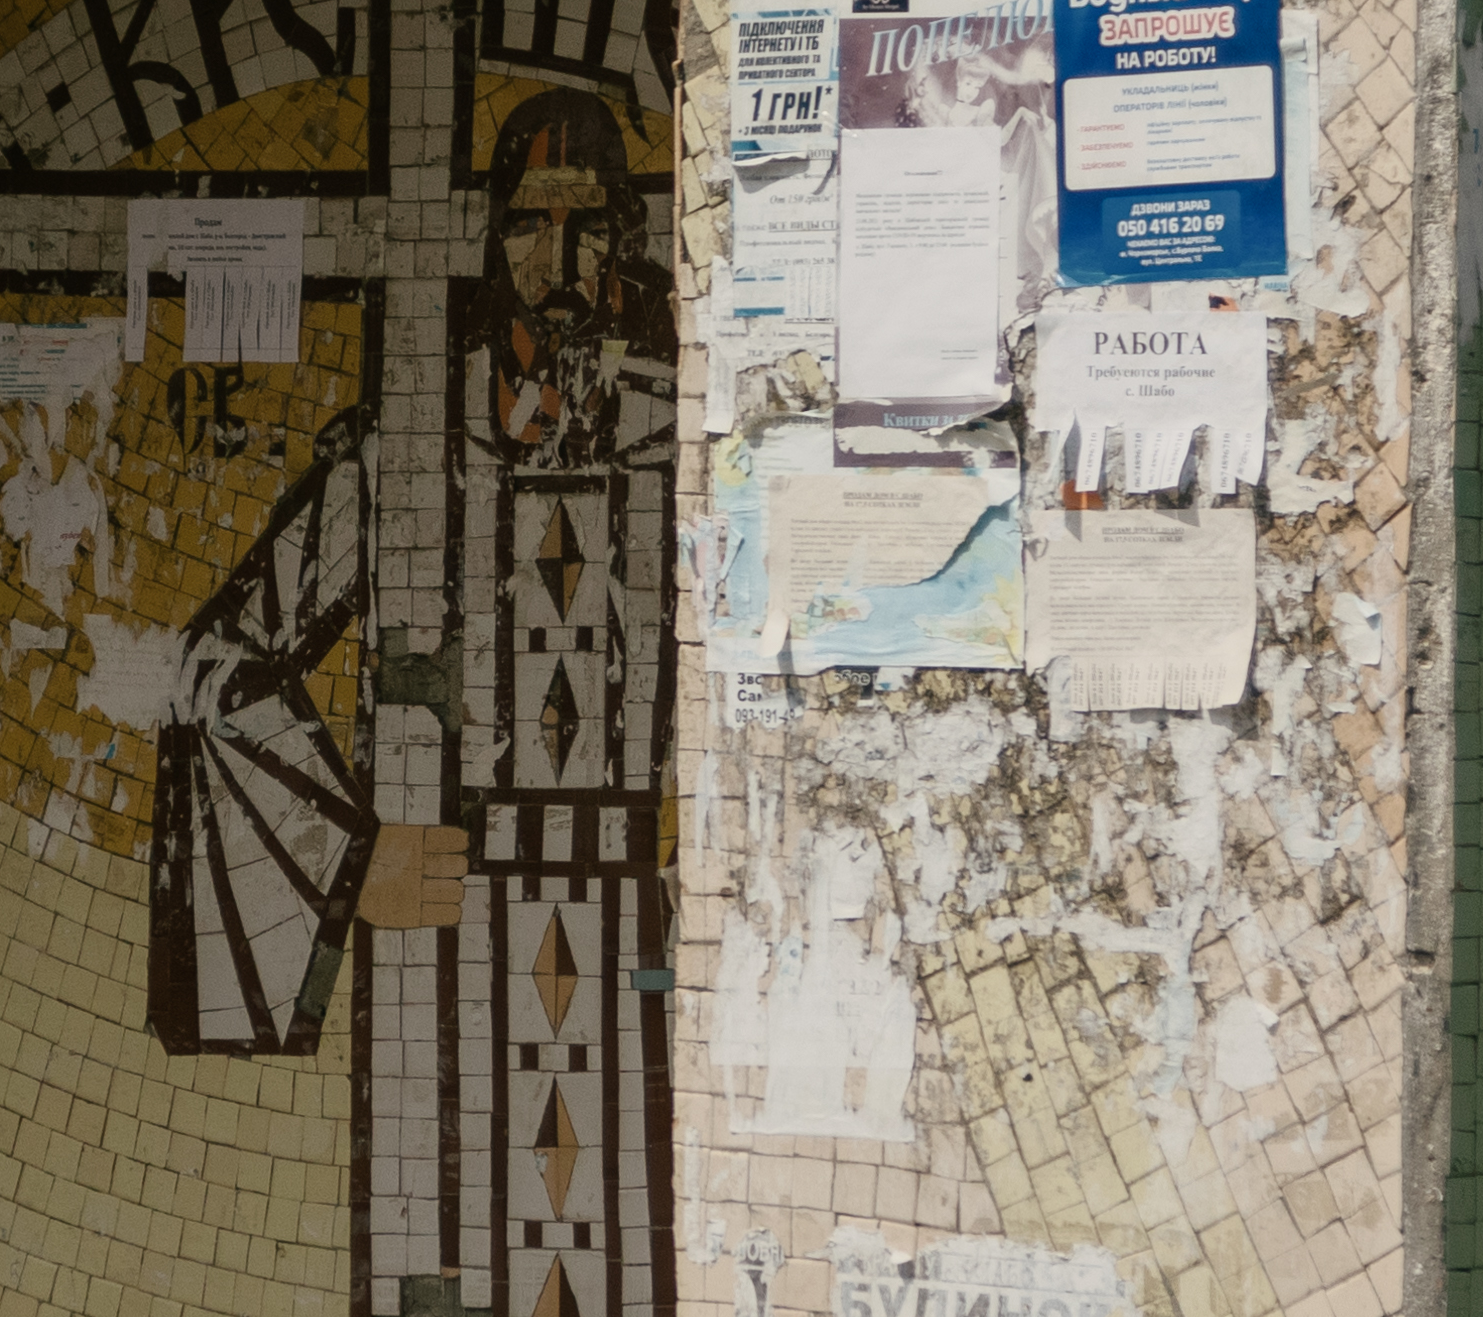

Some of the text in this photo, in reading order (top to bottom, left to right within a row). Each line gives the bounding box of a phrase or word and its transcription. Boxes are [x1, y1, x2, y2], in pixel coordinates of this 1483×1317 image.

[738, 20, 824, 38] ПІДКЛЮЧЕННЯ
[1103, 10, 1231, 41] ЗАПРОШУЄ
[738, 37, 796, 53] ІНТЕРНЕТУ
[1116, 46, 1217, 70] НА РОБОТУ!
[751, 88, 763, 122] 1
[1130, 199, 1210, 216] ДЗВОНИ ЗАРАЗ
[1117, 214, 1225, 237] 050 416 20 69
[1094, 331, 1208, 356] РАБОТА
[1164, 365, 1216, 381] рабочие
[1125, 384, 1175, 397] с. Шабо
